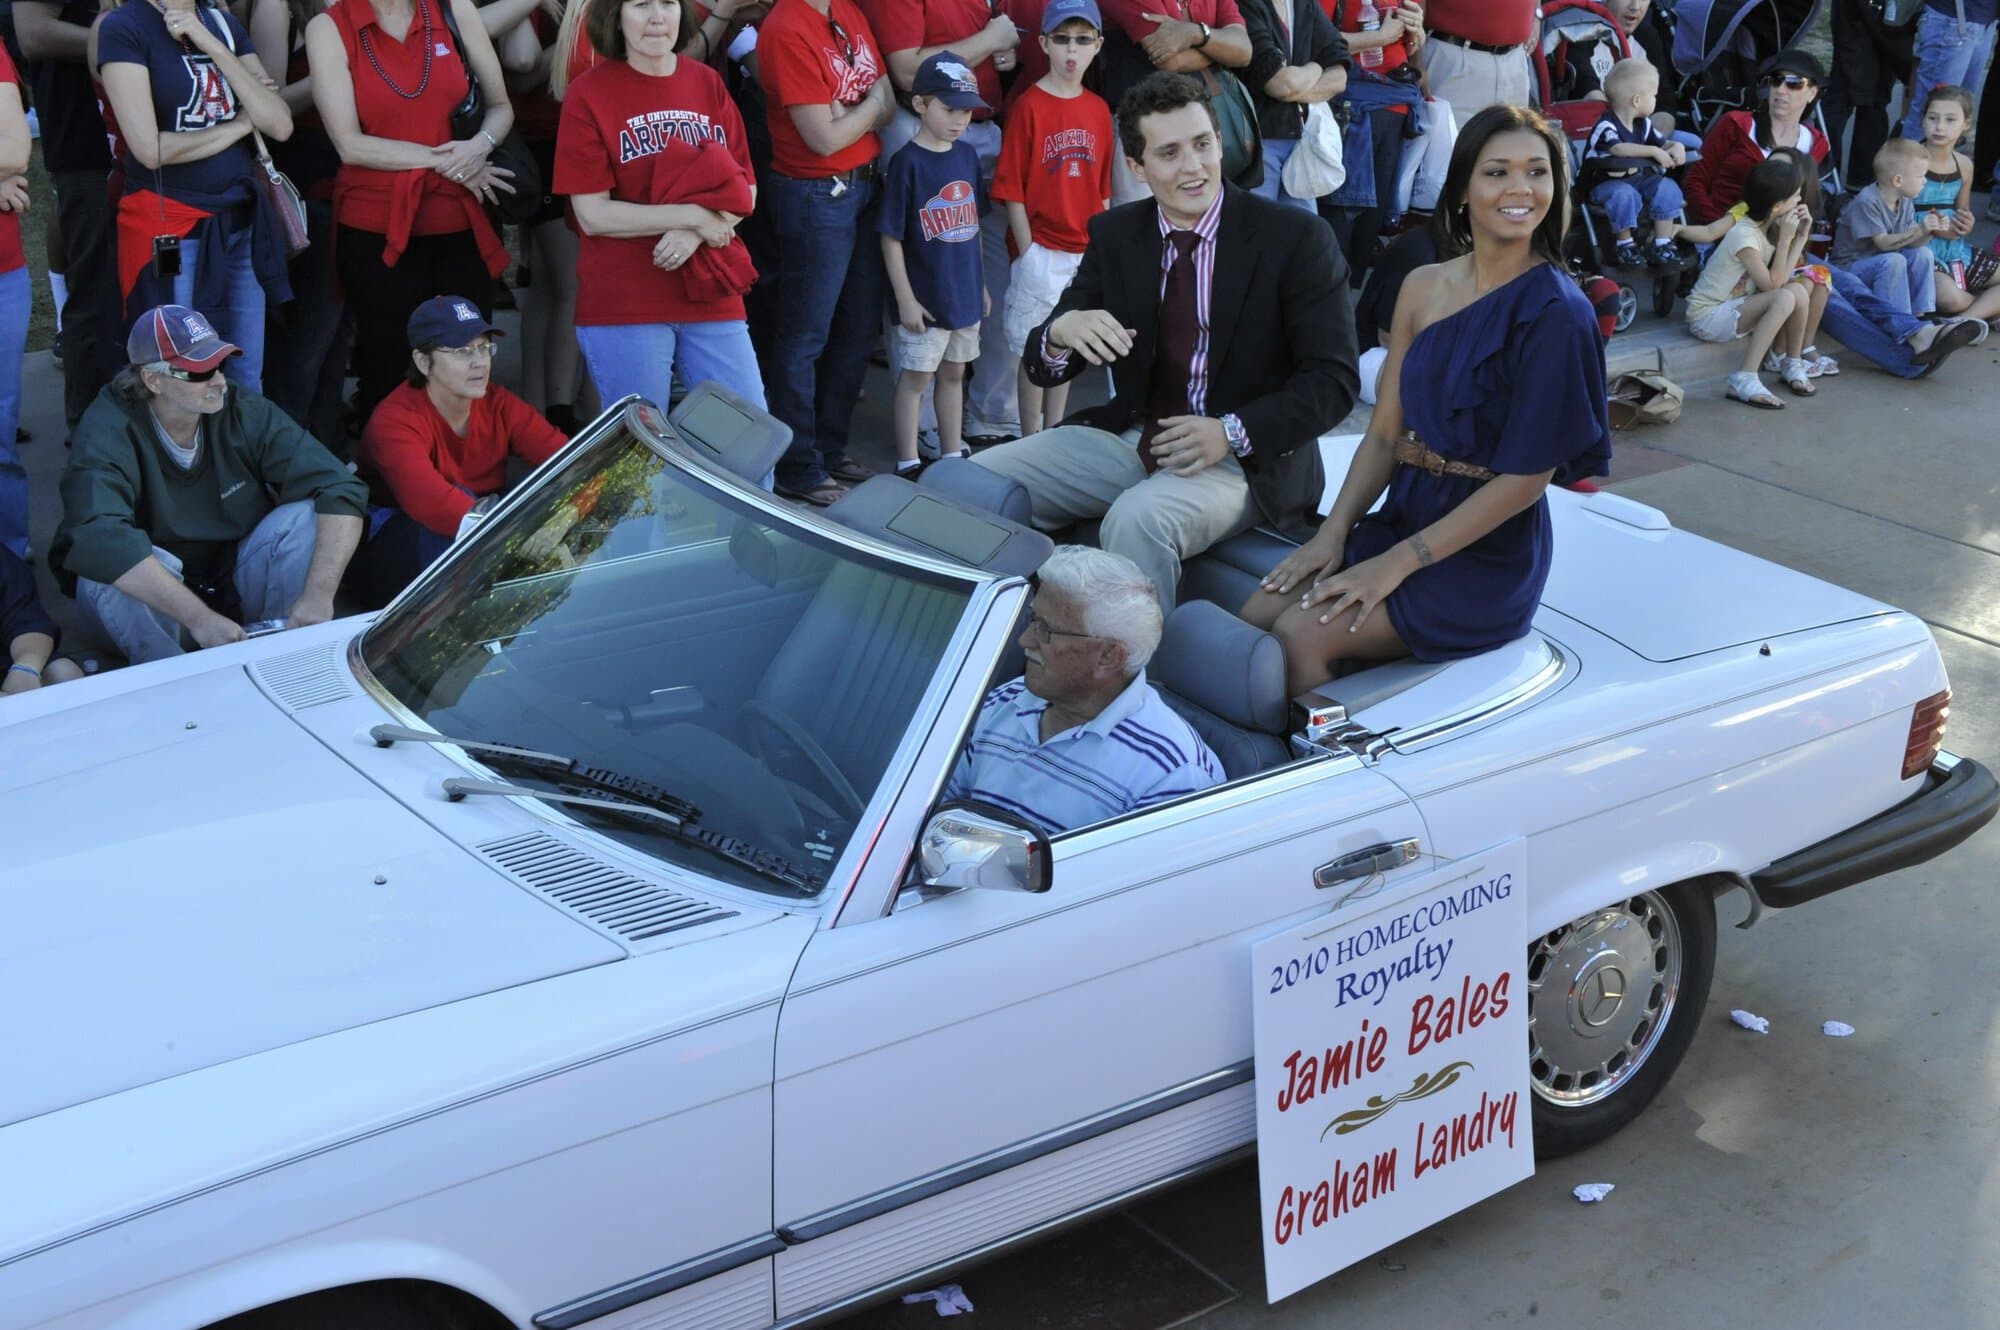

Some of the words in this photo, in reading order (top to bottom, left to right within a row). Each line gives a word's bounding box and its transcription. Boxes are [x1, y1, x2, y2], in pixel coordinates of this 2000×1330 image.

[627, 115, 645, 128] THE
[647, 110, 699, 122] UNIVERSITY
[1270, 948, 1330, 994] 2010
[1336, 874, 1512, 967] HOMECOMING
[1334, 937, 1454, 1008] Royalty
[1278, 1019, 1388, 1112] Jamie
[1408, 972, 1511, 1056] Bales
[1274, 1147, 1397, 1246] Graham
[1414, 1091, 1518, 1180] Landry
